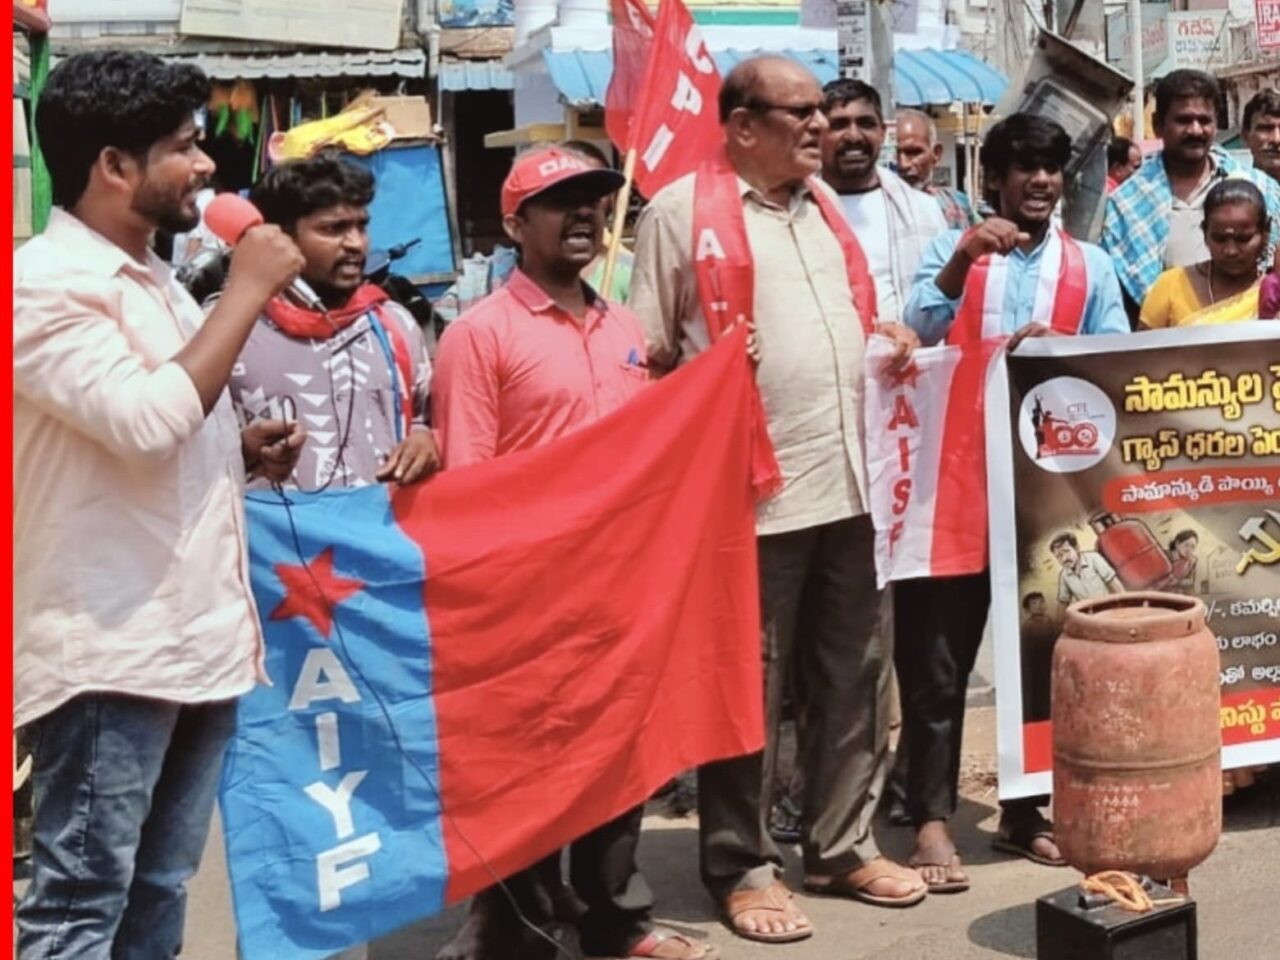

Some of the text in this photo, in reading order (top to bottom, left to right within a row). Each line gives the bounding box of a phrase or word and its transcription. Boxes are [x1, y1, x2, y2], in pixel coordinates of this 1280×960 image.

[642, 23, 714, 173] CPI
[1121, 428, 1180, 471] గ్యాస్
[1185, 431, 1245, 460] ధరల
[1124, 372, 1264, 420] సామన్యుల
[888, 394, 919, 559] AISF
[287, 648, 382, 912] AIYF
